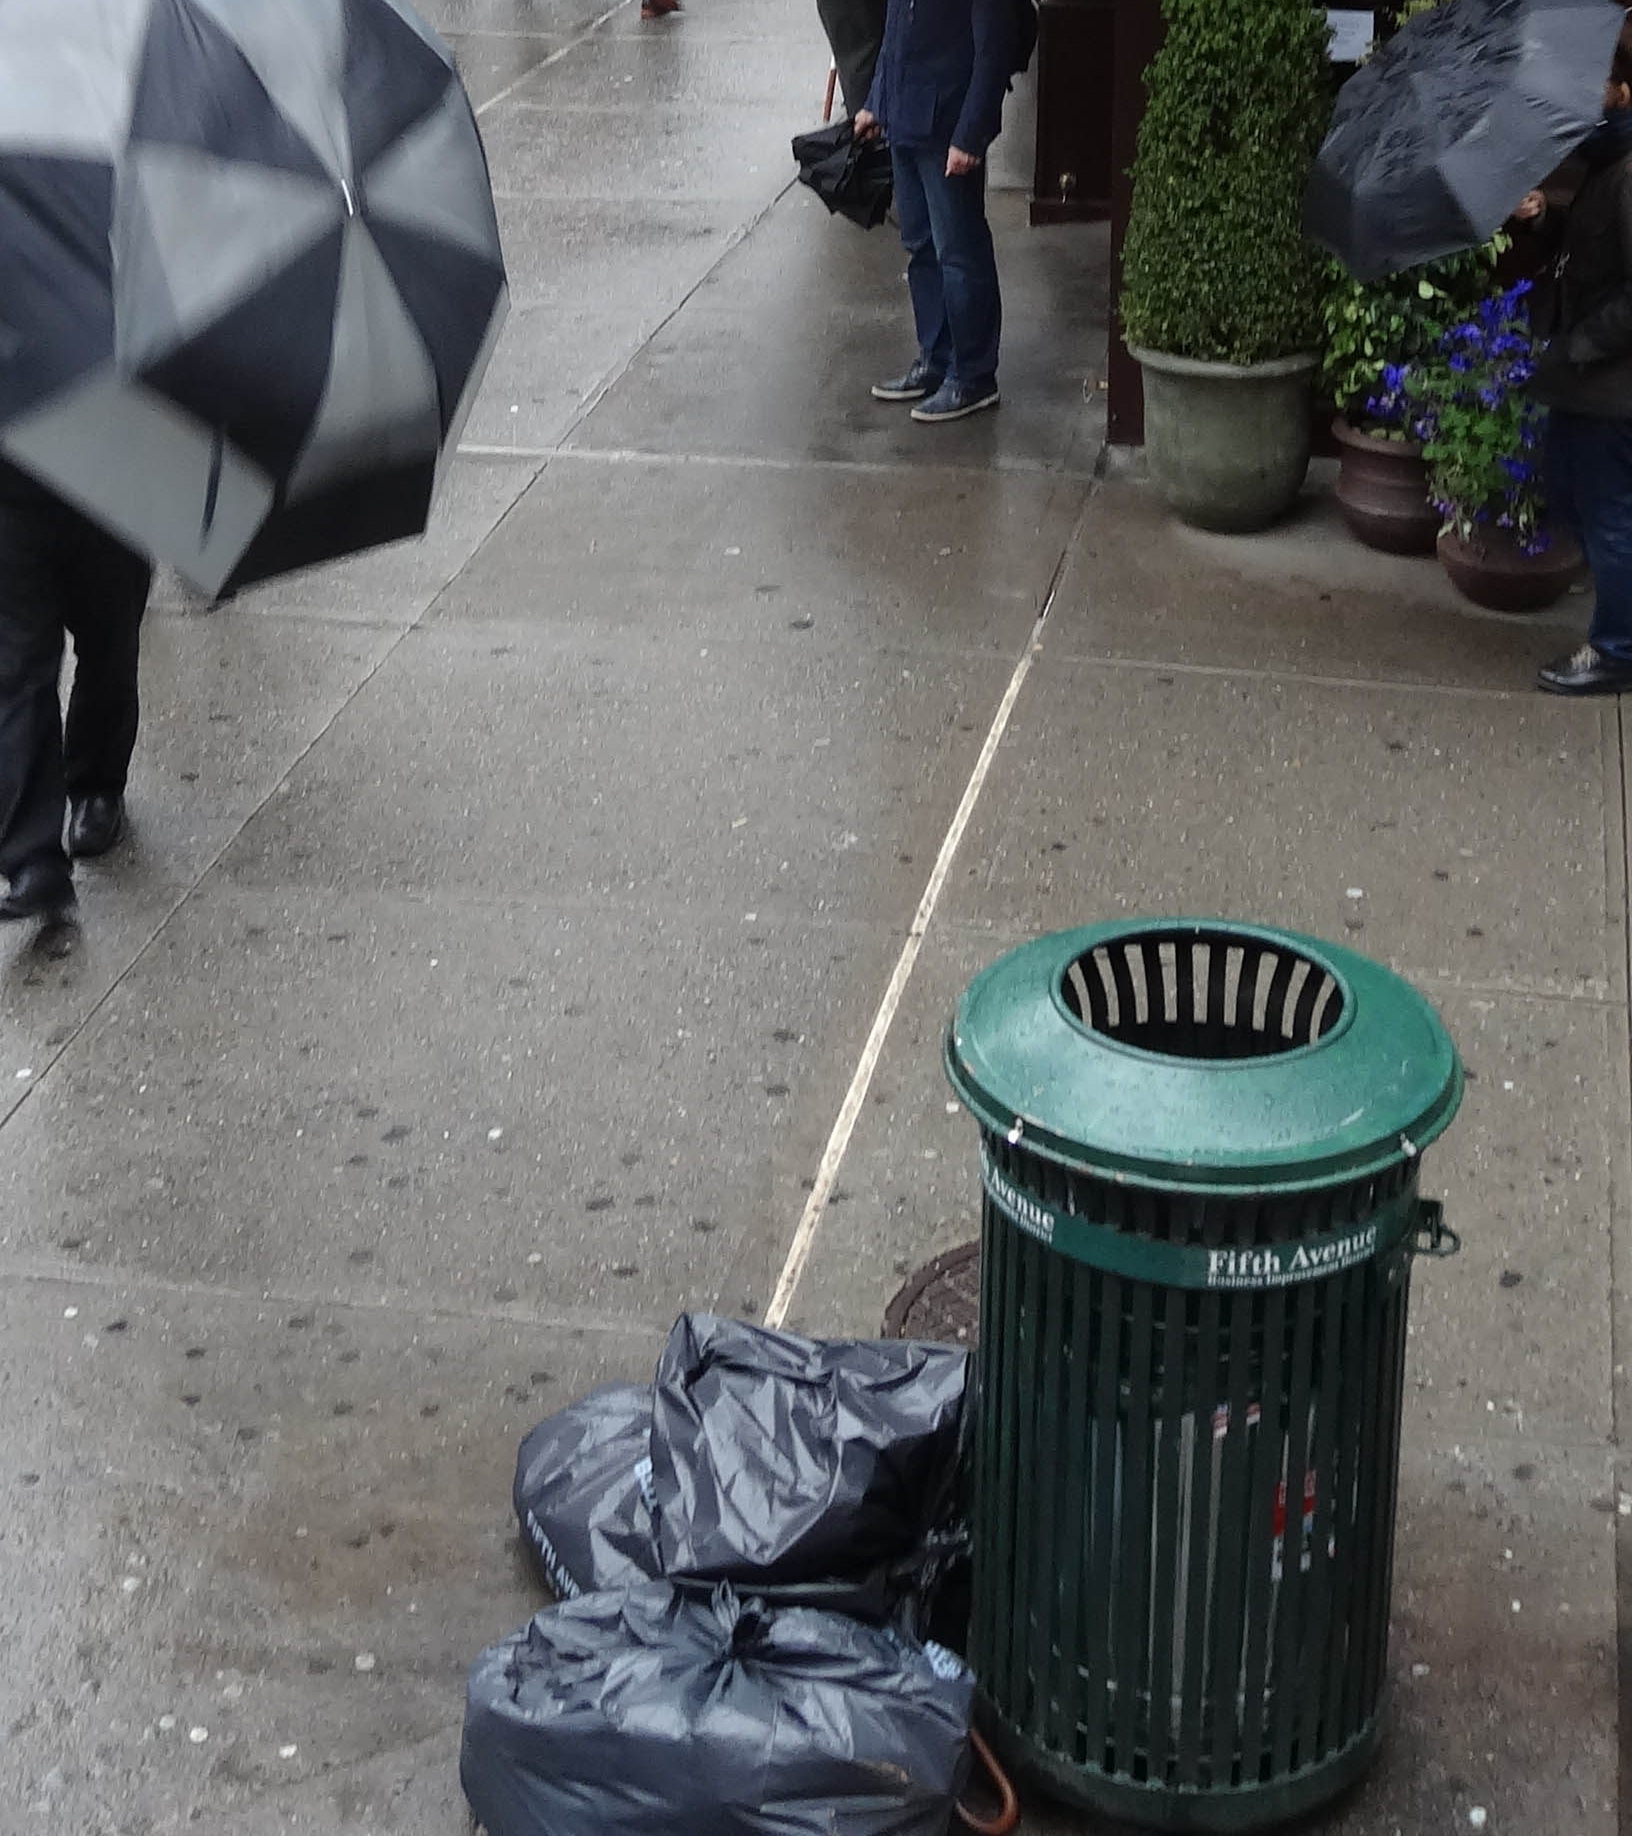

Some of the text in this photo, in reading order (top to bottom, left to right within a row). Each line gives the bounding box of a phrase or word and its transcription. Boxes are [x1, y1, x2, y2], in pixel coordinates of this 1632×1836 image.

[990, 1165, 1055, 1233] Avenue
[1208, 1225, 1377, 1276] Fifth Avenue
